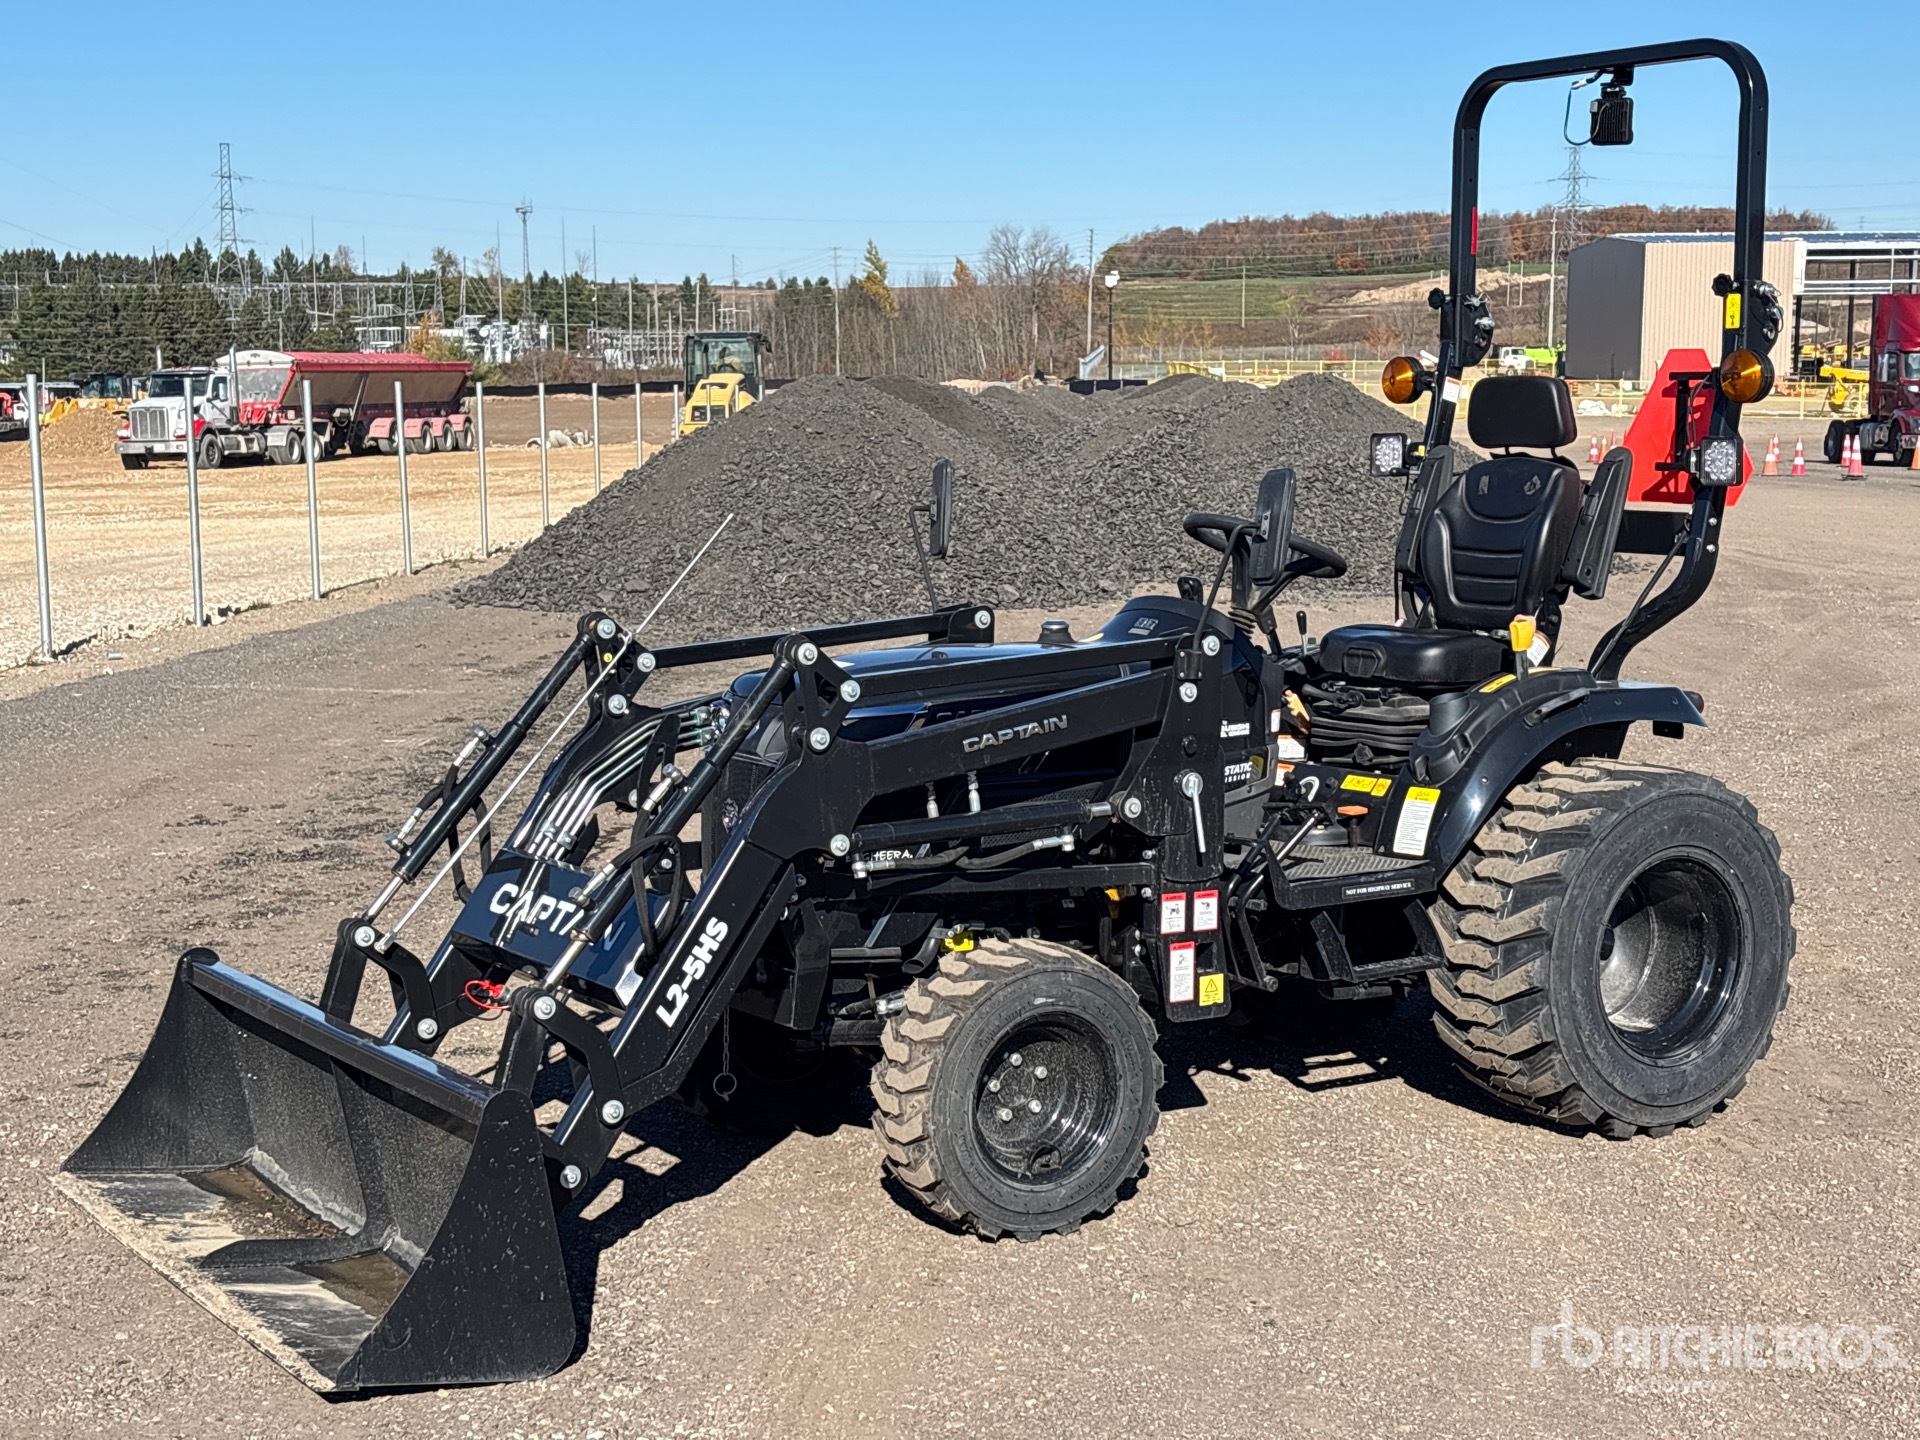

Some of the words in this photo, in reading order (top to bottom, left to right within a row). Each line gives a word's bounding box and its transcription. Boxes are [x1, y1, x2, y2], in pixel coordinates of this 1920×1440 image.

[962, 715, 1068, 753] CAPTAIN
[1224, 761, 1253, 776] STATIC
[655, 916, 729, 1028] L2-5HS
